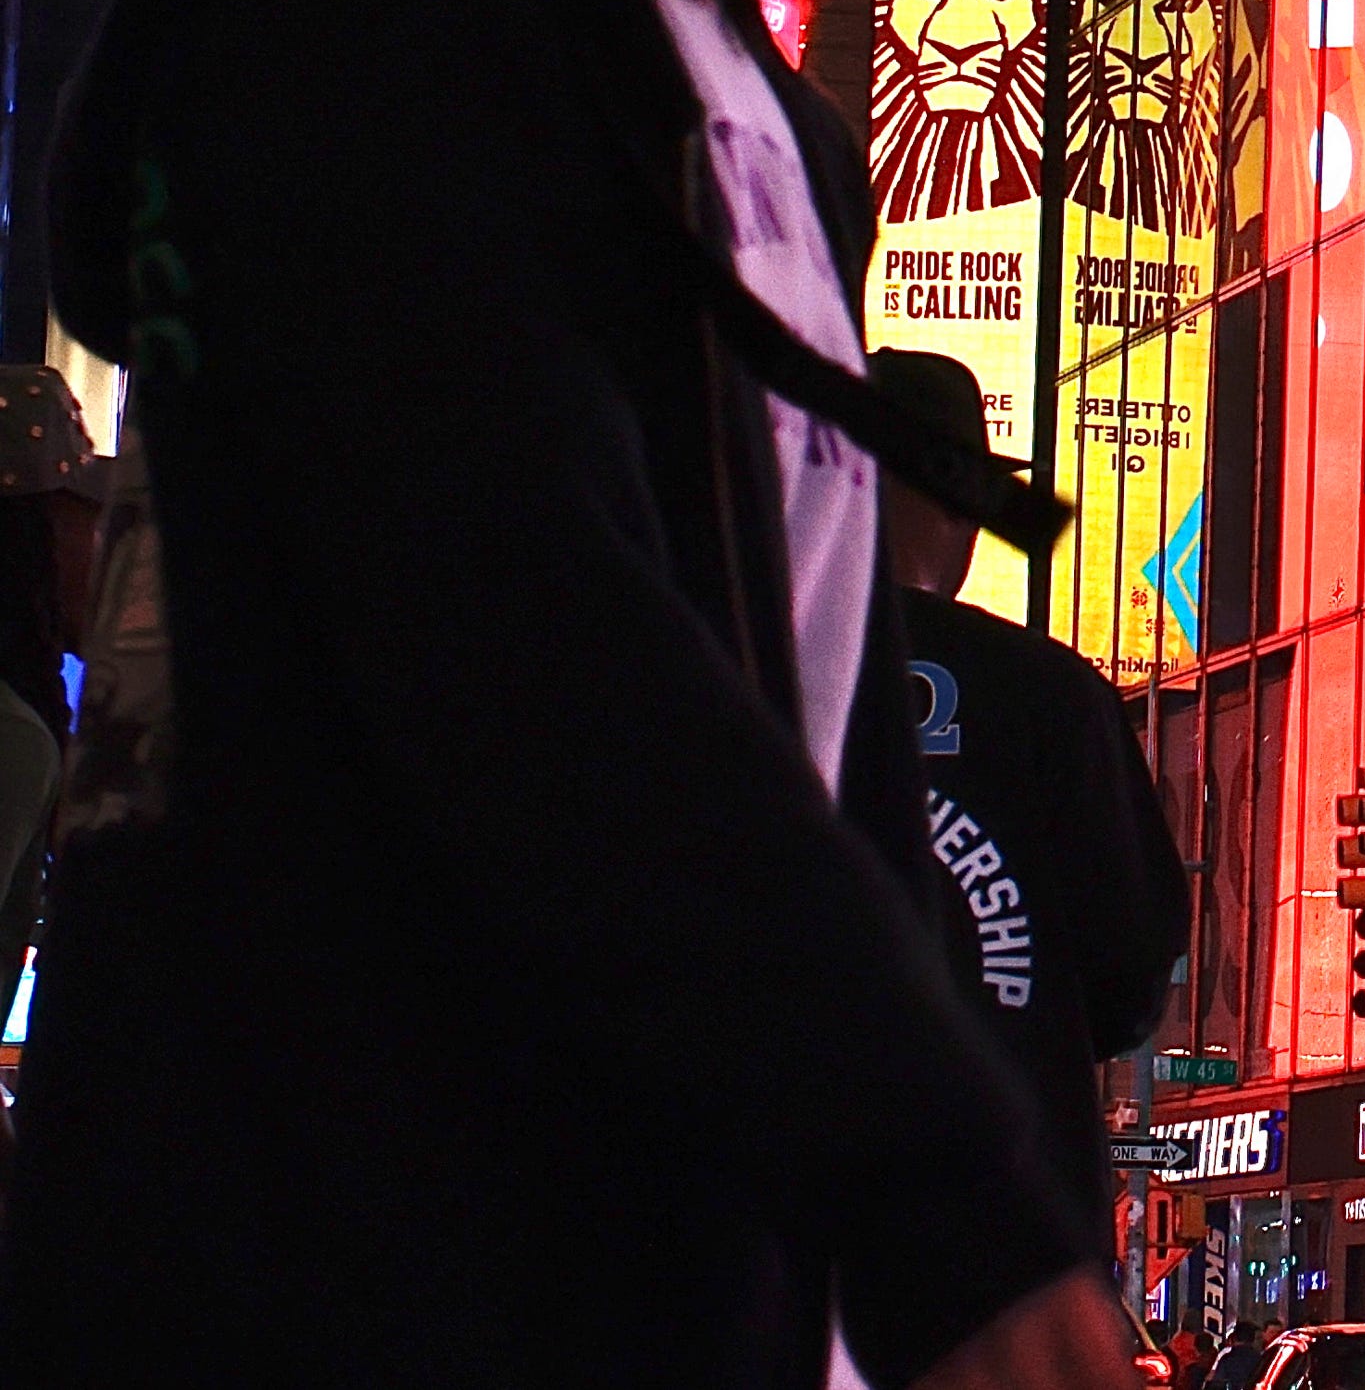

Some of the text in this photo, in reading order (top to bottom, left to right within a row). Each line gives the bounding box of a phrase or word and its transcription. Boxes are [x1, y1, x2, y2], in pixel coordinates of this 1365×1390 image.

[885, 250, 1022, 282] PRIDE ROCK
[884, 284, 1021, 321] IS CALLING
[1174, 1061, 1189, 1079] W
[1197, 1062, 1216, 1081] 45
[1111, 1146, 1179, 1160] ONE WAY
[1150, 1110, 1270, 1183] HERS
